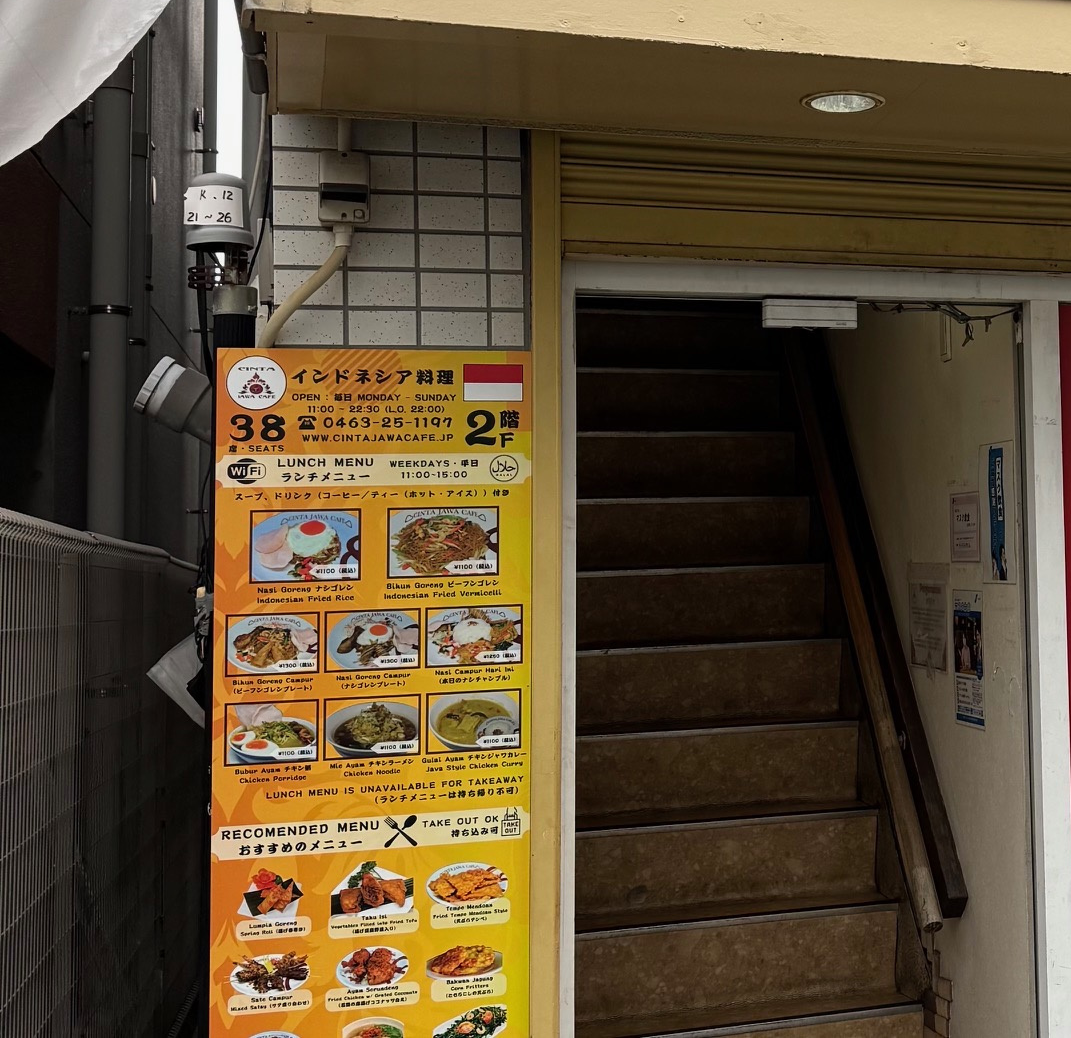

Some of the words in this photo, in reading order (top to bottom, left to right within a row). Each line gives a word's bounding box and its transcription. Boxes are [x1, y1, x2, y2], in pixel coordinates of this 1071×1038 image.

[216, 212, 232, 223] 26
[291, 369, 454, 386] インドネシア料理
[292, 394, 321, 402] OPEN
[358, 393, 401, 402] MONDAY
[414, 393, 456, 402] SUNDAY
[307, 405, 334, 413] 11:00
[349, 405, 380, 413] 22:30
[410, 405, 445, 414] 22:00)
[323, 416, 453, 429] 0463-25-1197
[499, 410, 519, 428] 階
[229, 414, 286, 442] 38
[302, 433, 454, 442] WWW.CINTAJAWACAFE.JP
[499, 432, 514, 448] F
[277, 457, 326, 467] LUNCH
[334, 457, 374, 467] MENU
[281, 472, 371, 482] ランチメニュー
[316, 584, 354, 592] ナシゴレン
[257, 596, 304, 604] Indonesian
[384, 592, 429, 600] Indonesian
[368, 759, 414, 767] チキンラーメン
[240, 776, 270, 784] Chicken
[266, 789, 303, 800] LUNCH
[308, 787, 339, 797] MENU
[344, 787, 355, 795] IS
[360, 782, 436, 794] UNAVAILABLE
[442, 780, 462, 789] FOR
[468, 776, 524, 787] TAKEAWAY
[422, 819, 451, 827] TAKE
[458, 817, 479, 825] OUT
[485, 815, 499, 823] OK
[221, 824, 328, 840] RECOMENDED
[338, 820, 379, 833] MENU
[239, 840, 363, 856] おすすめのメニュー
